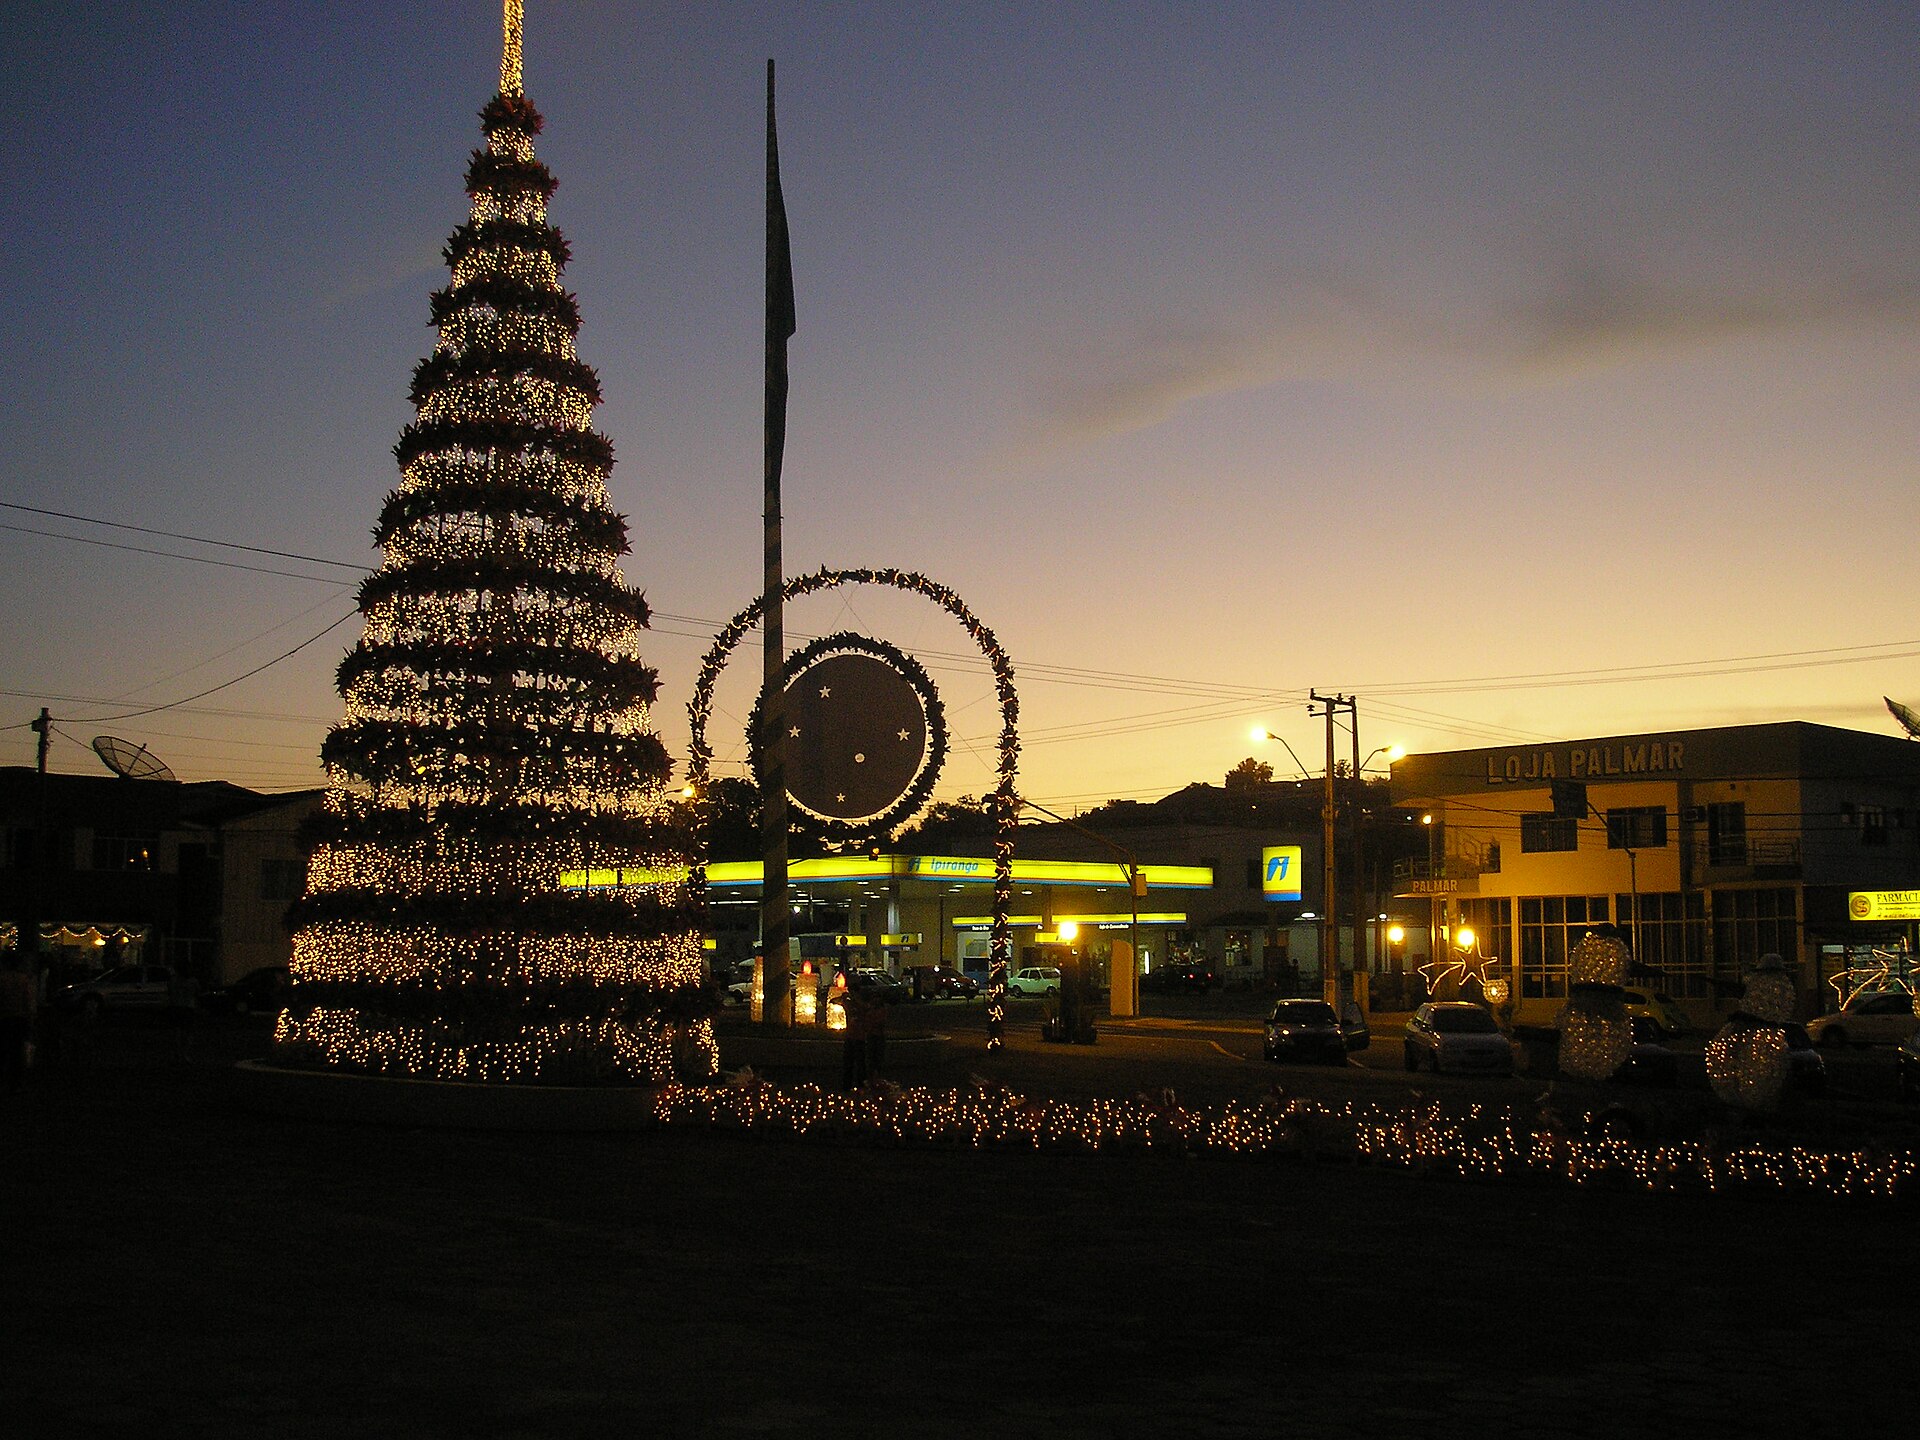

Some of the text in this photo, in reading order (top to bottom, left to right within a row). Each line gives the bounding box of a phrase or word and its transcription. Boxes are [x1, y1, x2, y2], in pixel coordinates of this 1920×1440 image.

[1487, 741, 1685, 785] LOJA PALMAR
[931, 858, 979, 873] Ipiranga
[1412, 880, 1458, 893] PALMAR
